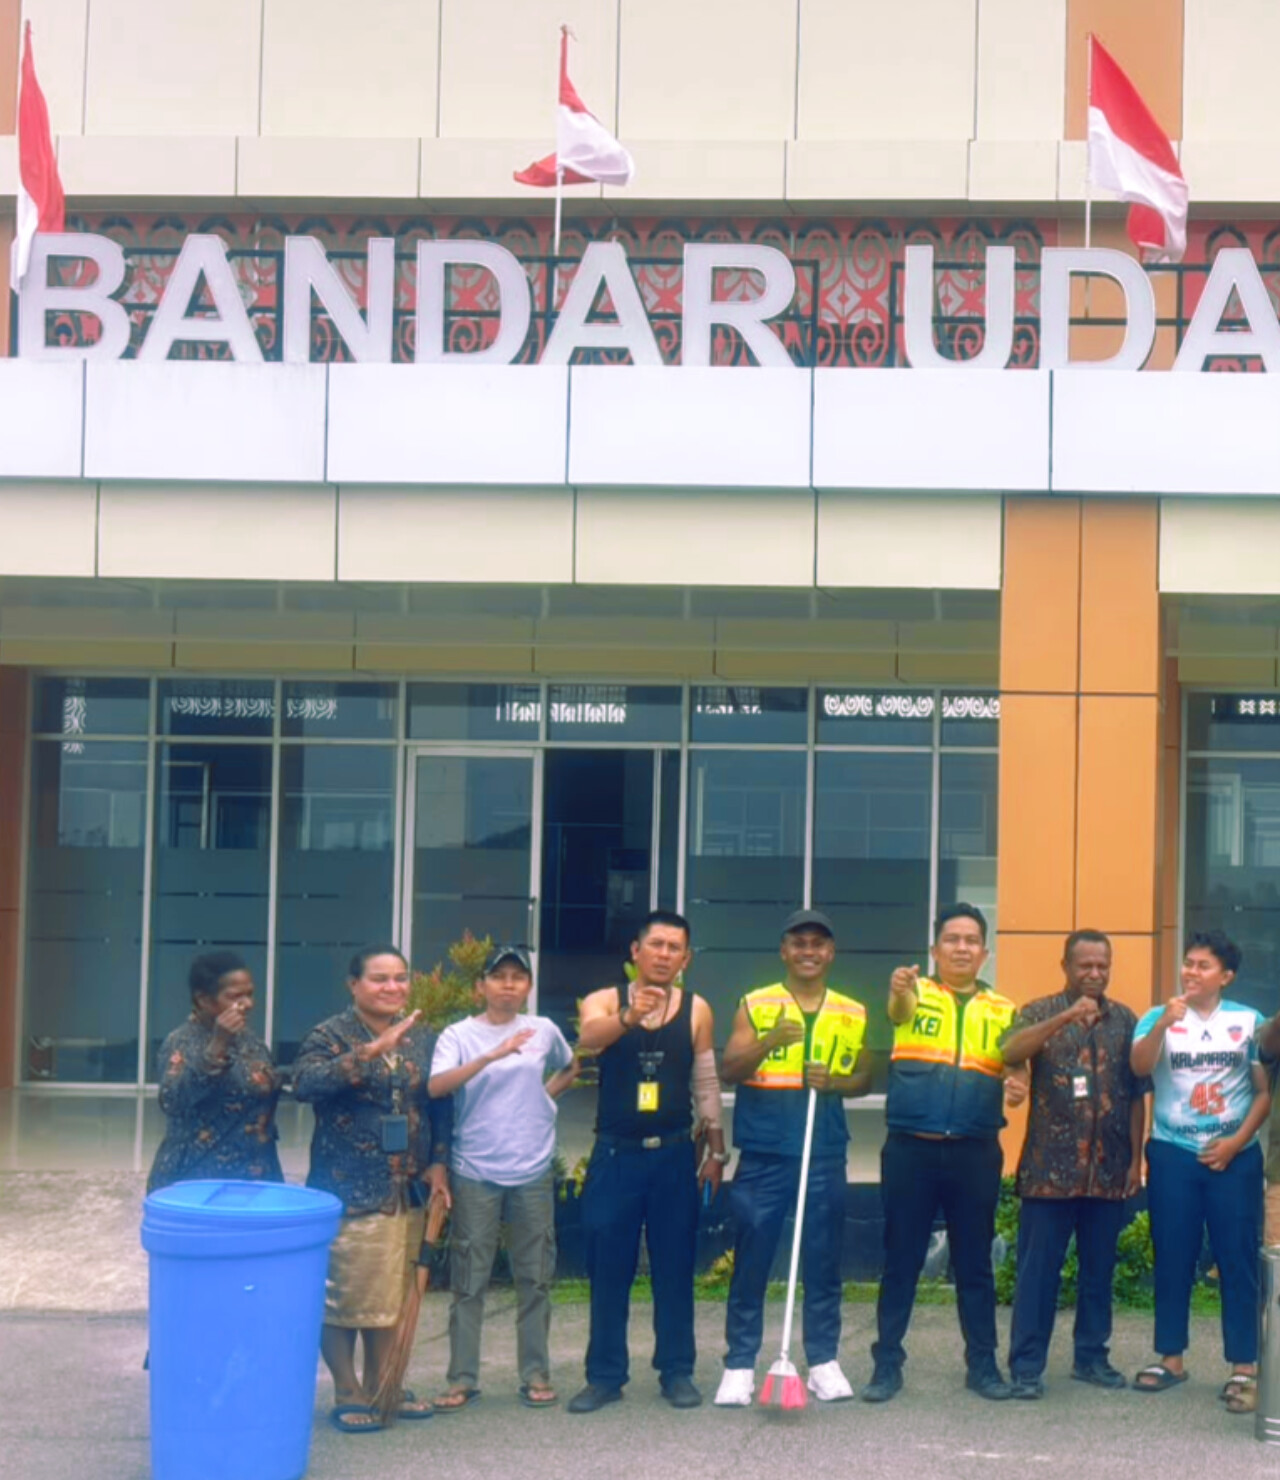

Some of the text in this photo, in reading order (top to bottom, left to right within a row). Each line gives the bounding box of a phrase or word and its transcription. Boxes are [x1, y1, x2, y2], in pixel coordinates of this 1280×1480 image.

[17, 232, 803, 366] BANDAR
[912, 1013, 942, 1037] KEI
[1190, 1081, 1225, 1115] 45
